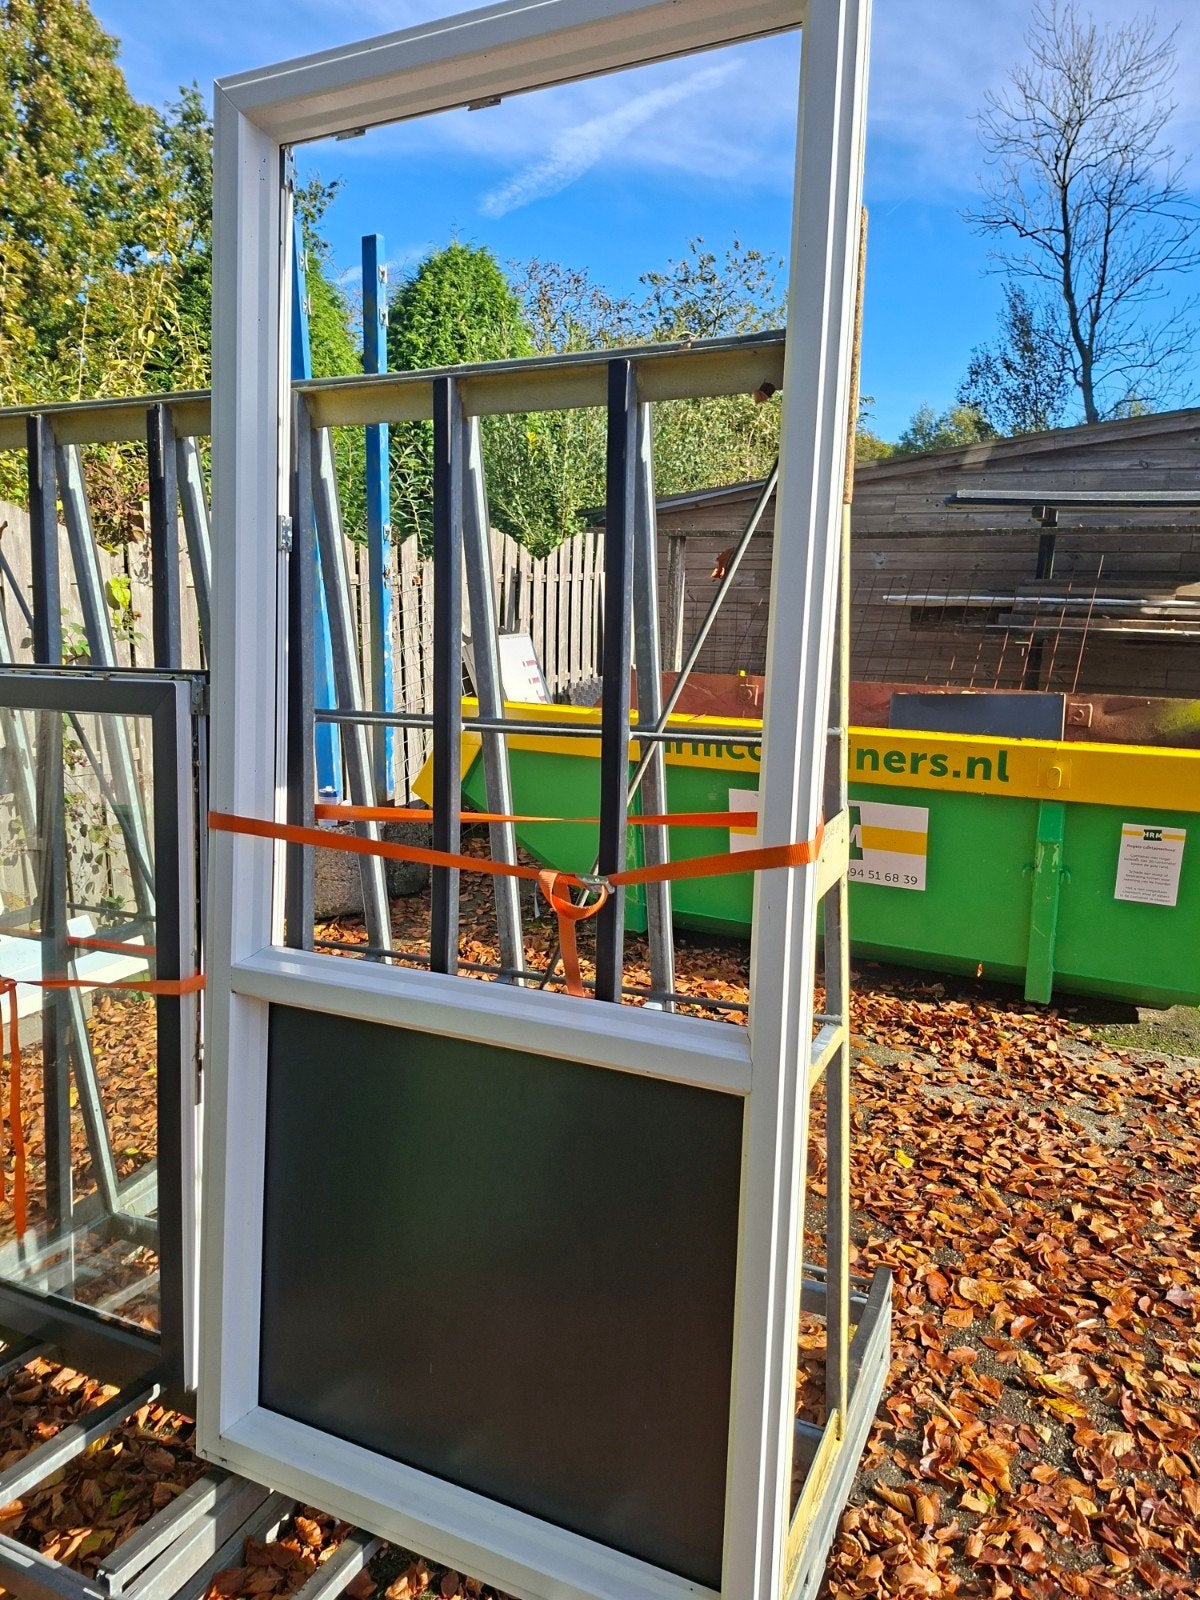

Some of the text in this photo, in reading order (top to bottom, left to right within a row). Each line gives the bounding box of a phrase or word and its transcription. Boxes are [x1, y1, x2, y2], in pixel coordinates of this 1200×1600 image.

[848, 867, 918, 885] 94 51 68 39
